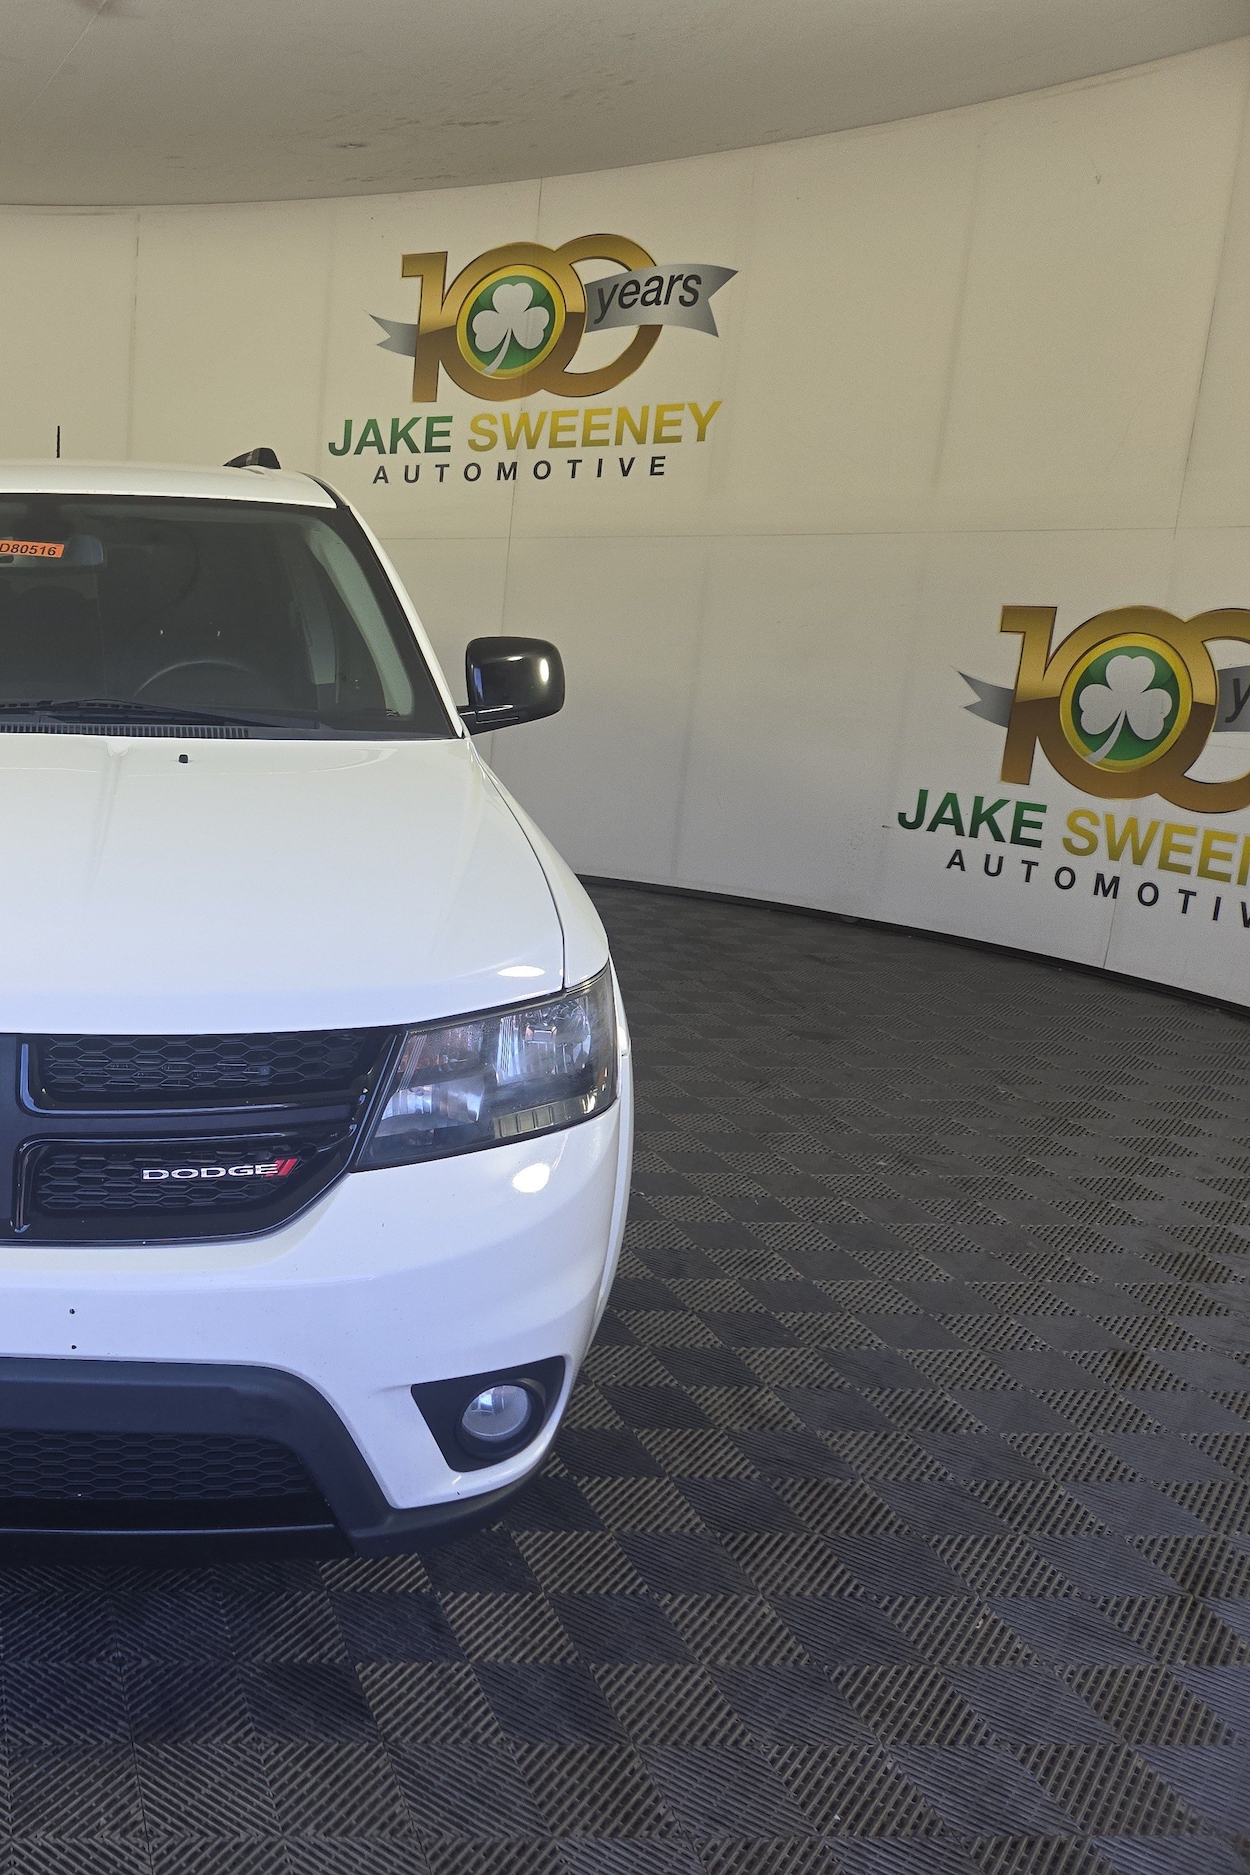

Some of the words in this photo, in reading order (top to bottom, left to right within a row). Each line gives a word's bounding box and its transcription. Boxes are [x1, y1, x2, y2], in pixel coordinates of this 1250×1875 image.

[402, 234, 663, 402] 100
[593, 272, 702, 324] years
[328, 415, 453, 456] JAKE
[467, 401, 723, 452] SWEENEY
[373, 456, 666, 484] AUTOMOTIVE
[0, 543, 57, 556] D80516
[898, 789, 1047, 848] JAKE
[142, 1163, 279, 1180] DODGE
